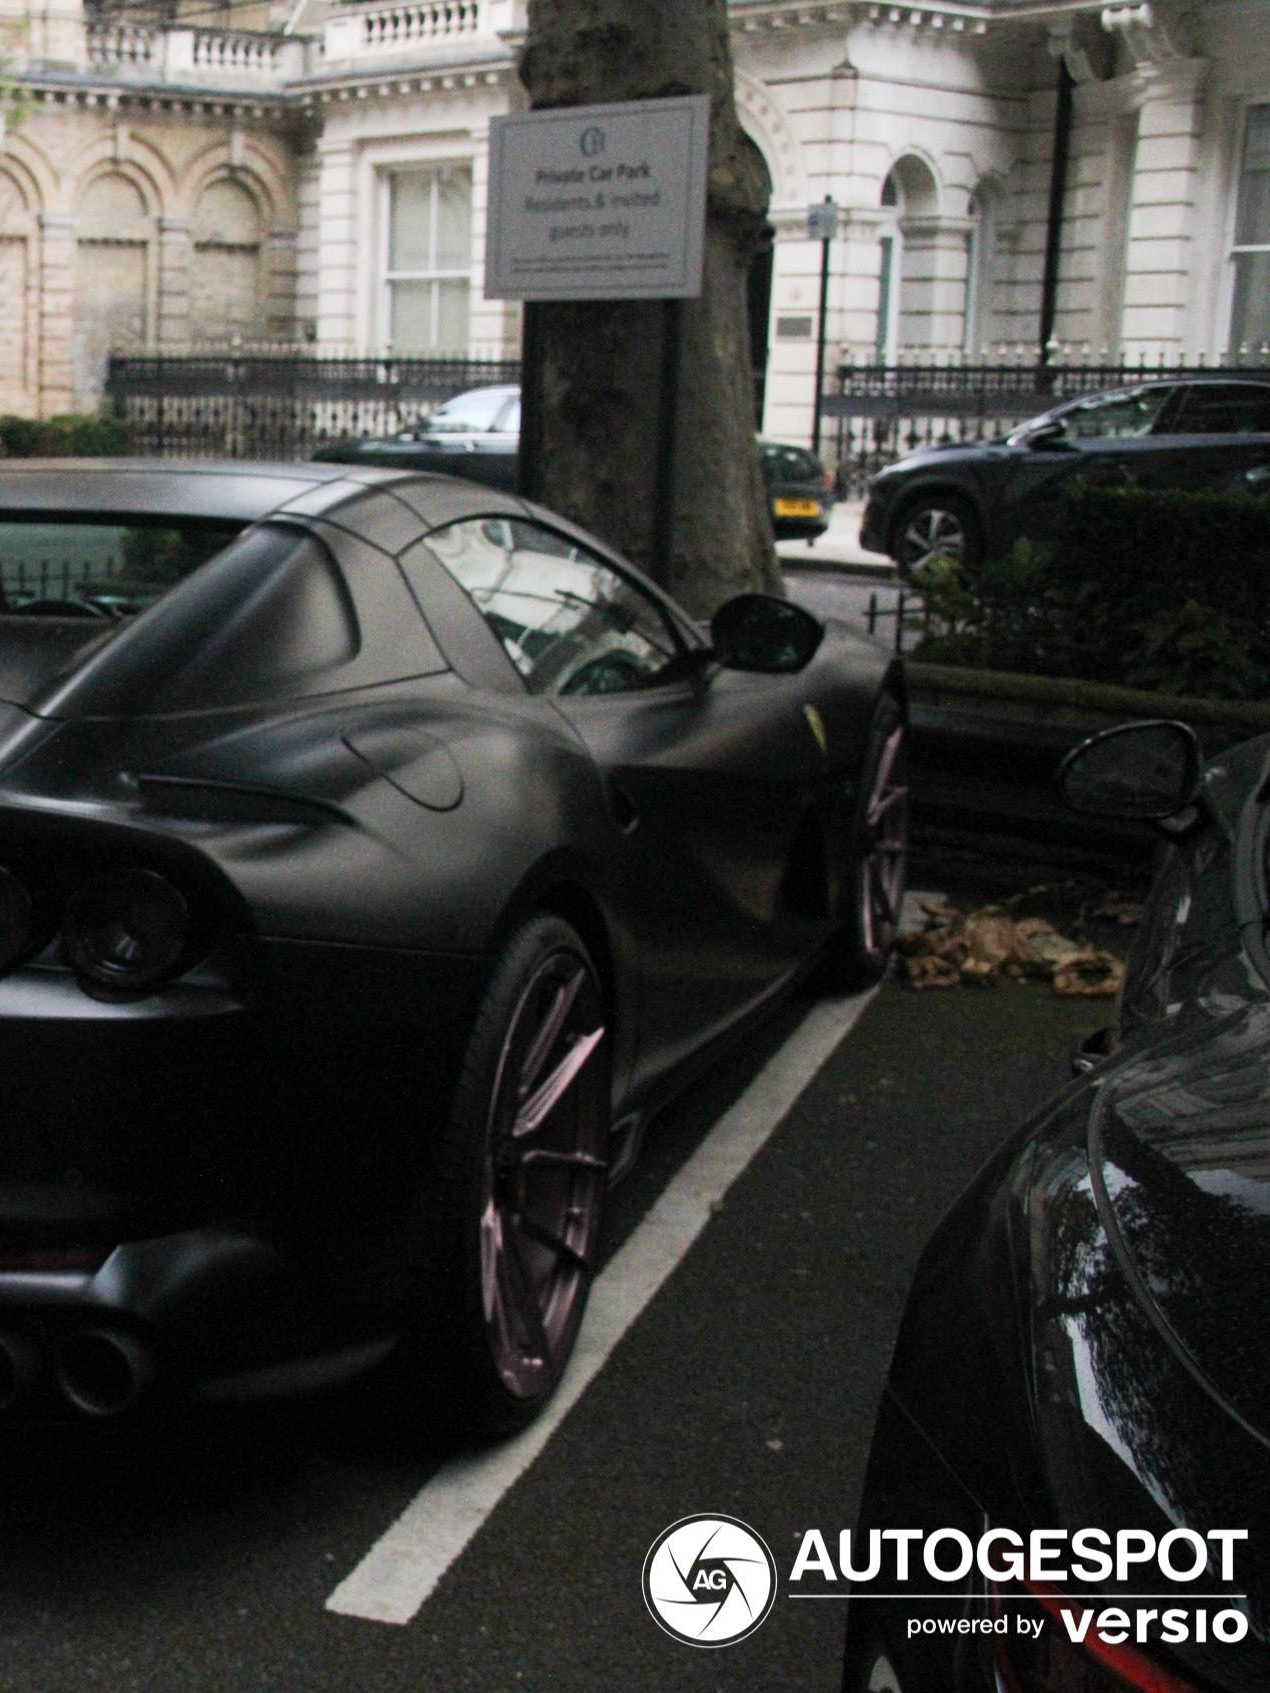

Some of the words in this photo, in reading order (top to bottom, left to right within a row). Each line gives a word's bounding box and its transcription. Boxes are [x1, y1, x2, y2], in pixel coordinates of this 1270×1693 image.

[535, 168, 584, 185] Private
[589, 164, 613, 183] Car
[617, 159, 652, 179] Park
[598, 219, 630, 239] only
